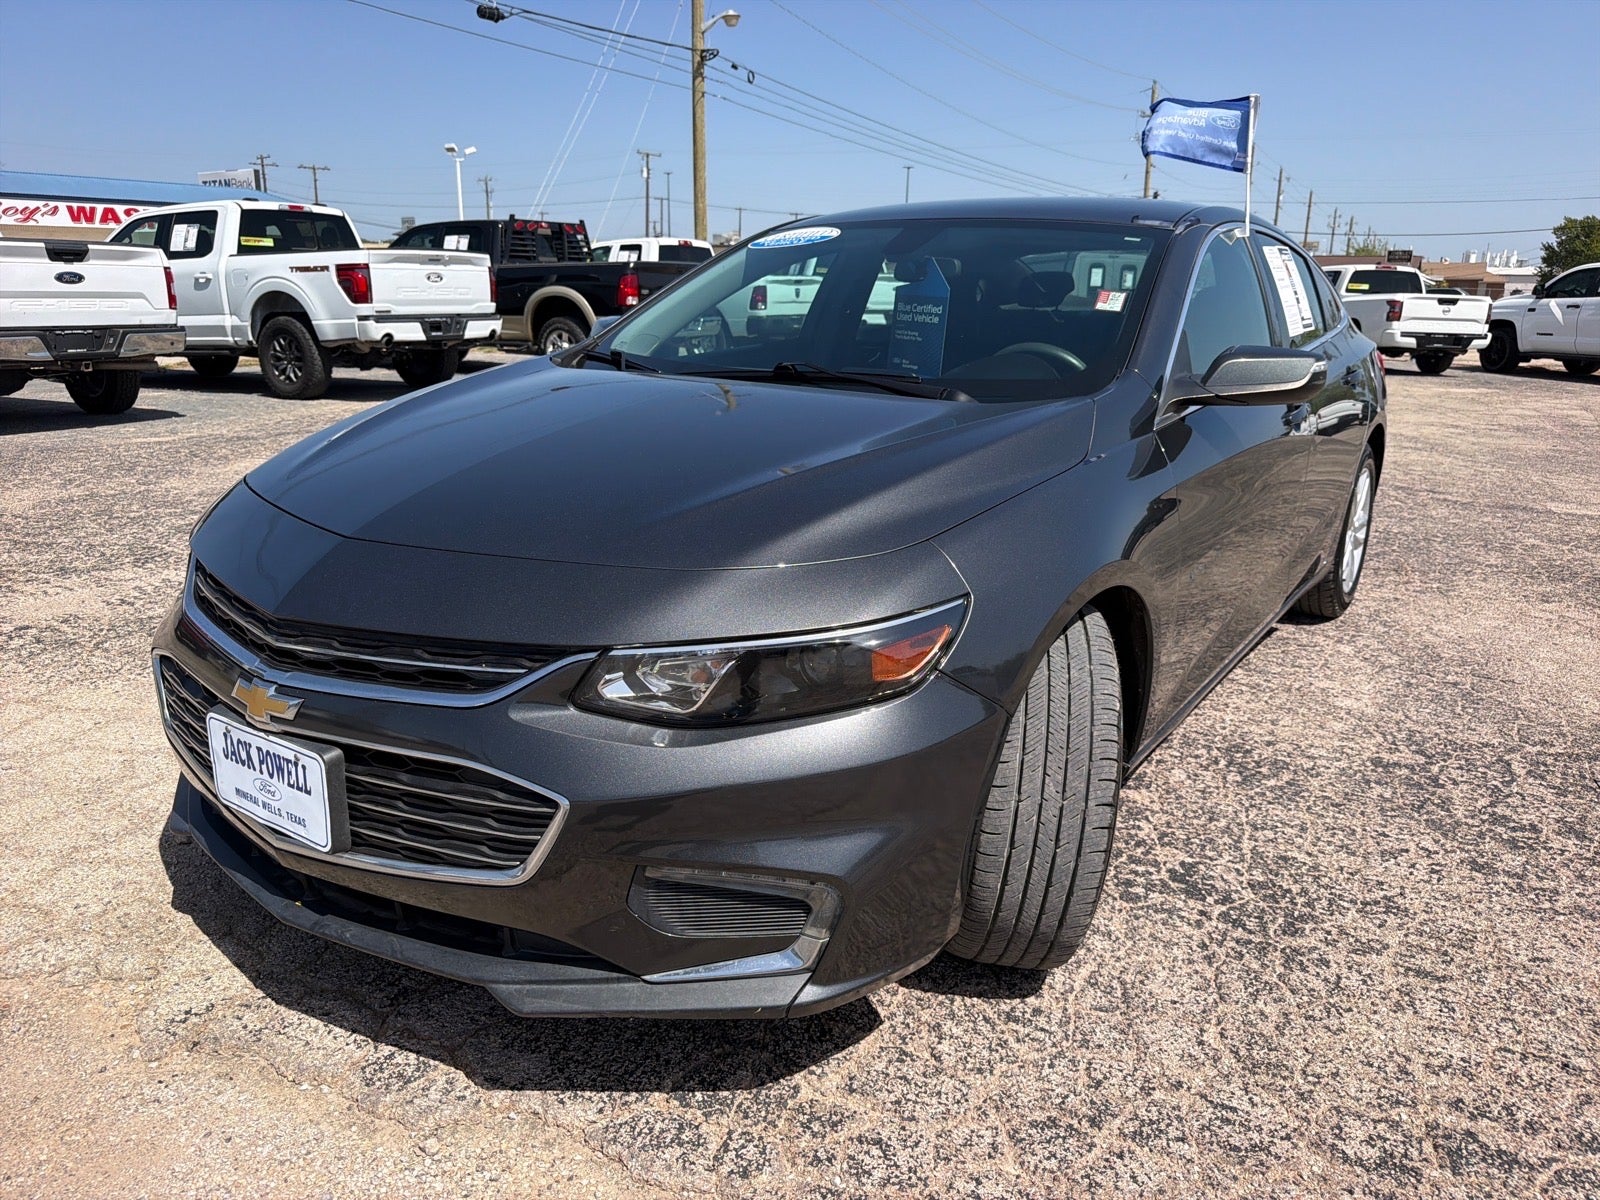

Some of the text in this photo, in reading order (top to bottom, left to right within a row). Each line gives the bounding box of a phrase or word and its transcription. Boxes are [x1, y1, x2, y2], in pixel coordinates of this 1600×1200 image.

[0, 202, 60, 224] oy's
[896, 312, 940, 324] Used Vehicle
[897, 302, 943, 314] Blue Certified
[222, 731, 312, 796] JACK POWELL
[235, 786, 307, 829] MINERAL WELLS, TEXAS
